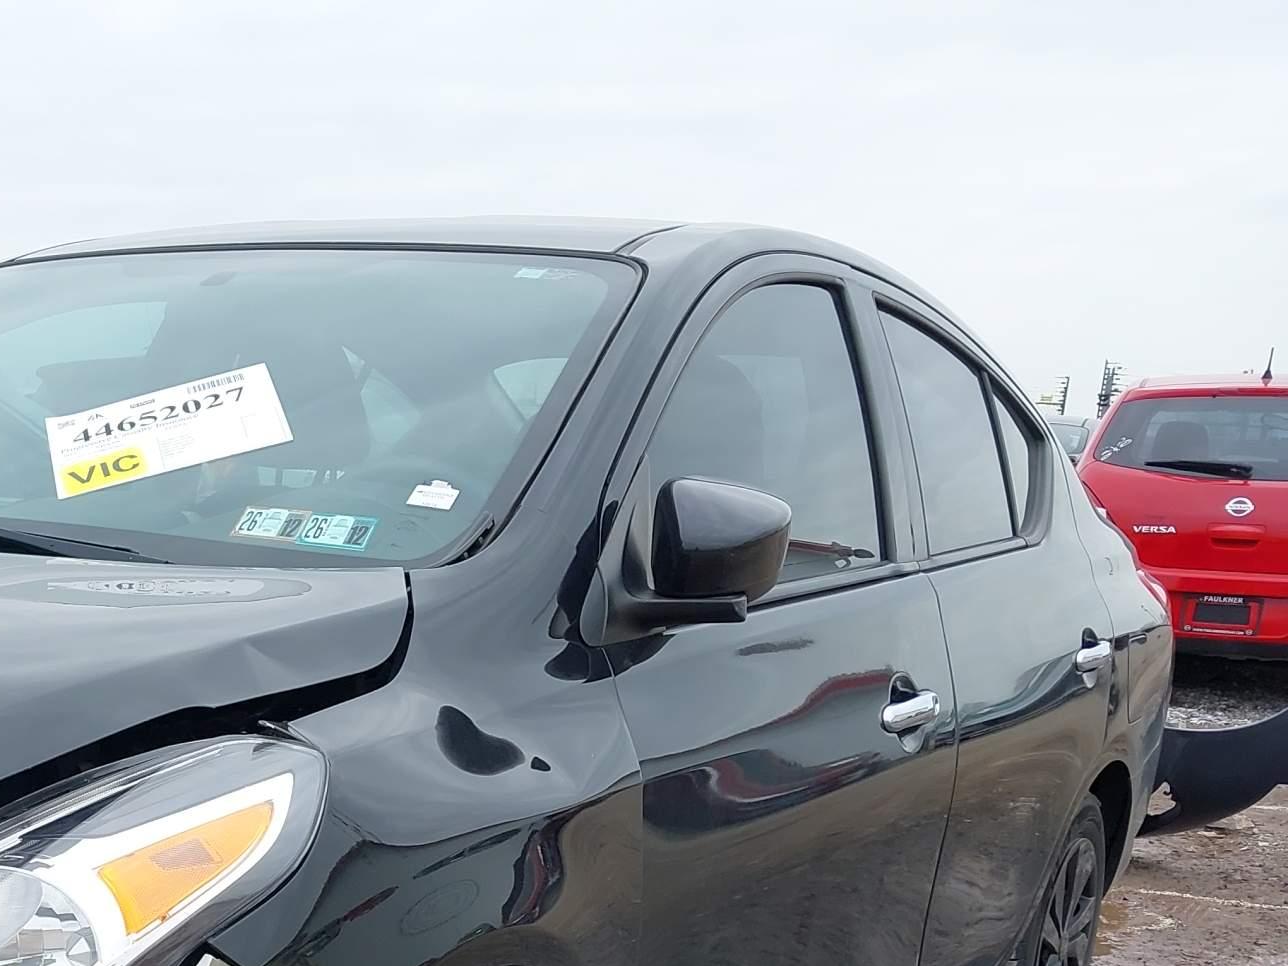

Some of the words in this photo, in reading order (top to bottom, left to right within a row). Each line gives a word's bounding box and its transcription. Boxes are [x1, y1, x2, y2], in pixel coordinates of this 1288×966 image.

[72, 386, 245, 443] 44652027
[67, 454, 140, 484] VIC
[239, 510, 263, 532] 26
[279, 518, 303, 538] 12
[304, 517, 328, 539] 26
[347, 525, 369, 546] 12
[1133, 525, 1176, 533] VERSA
[1204, 595, 1243, 603] FAULKNER
